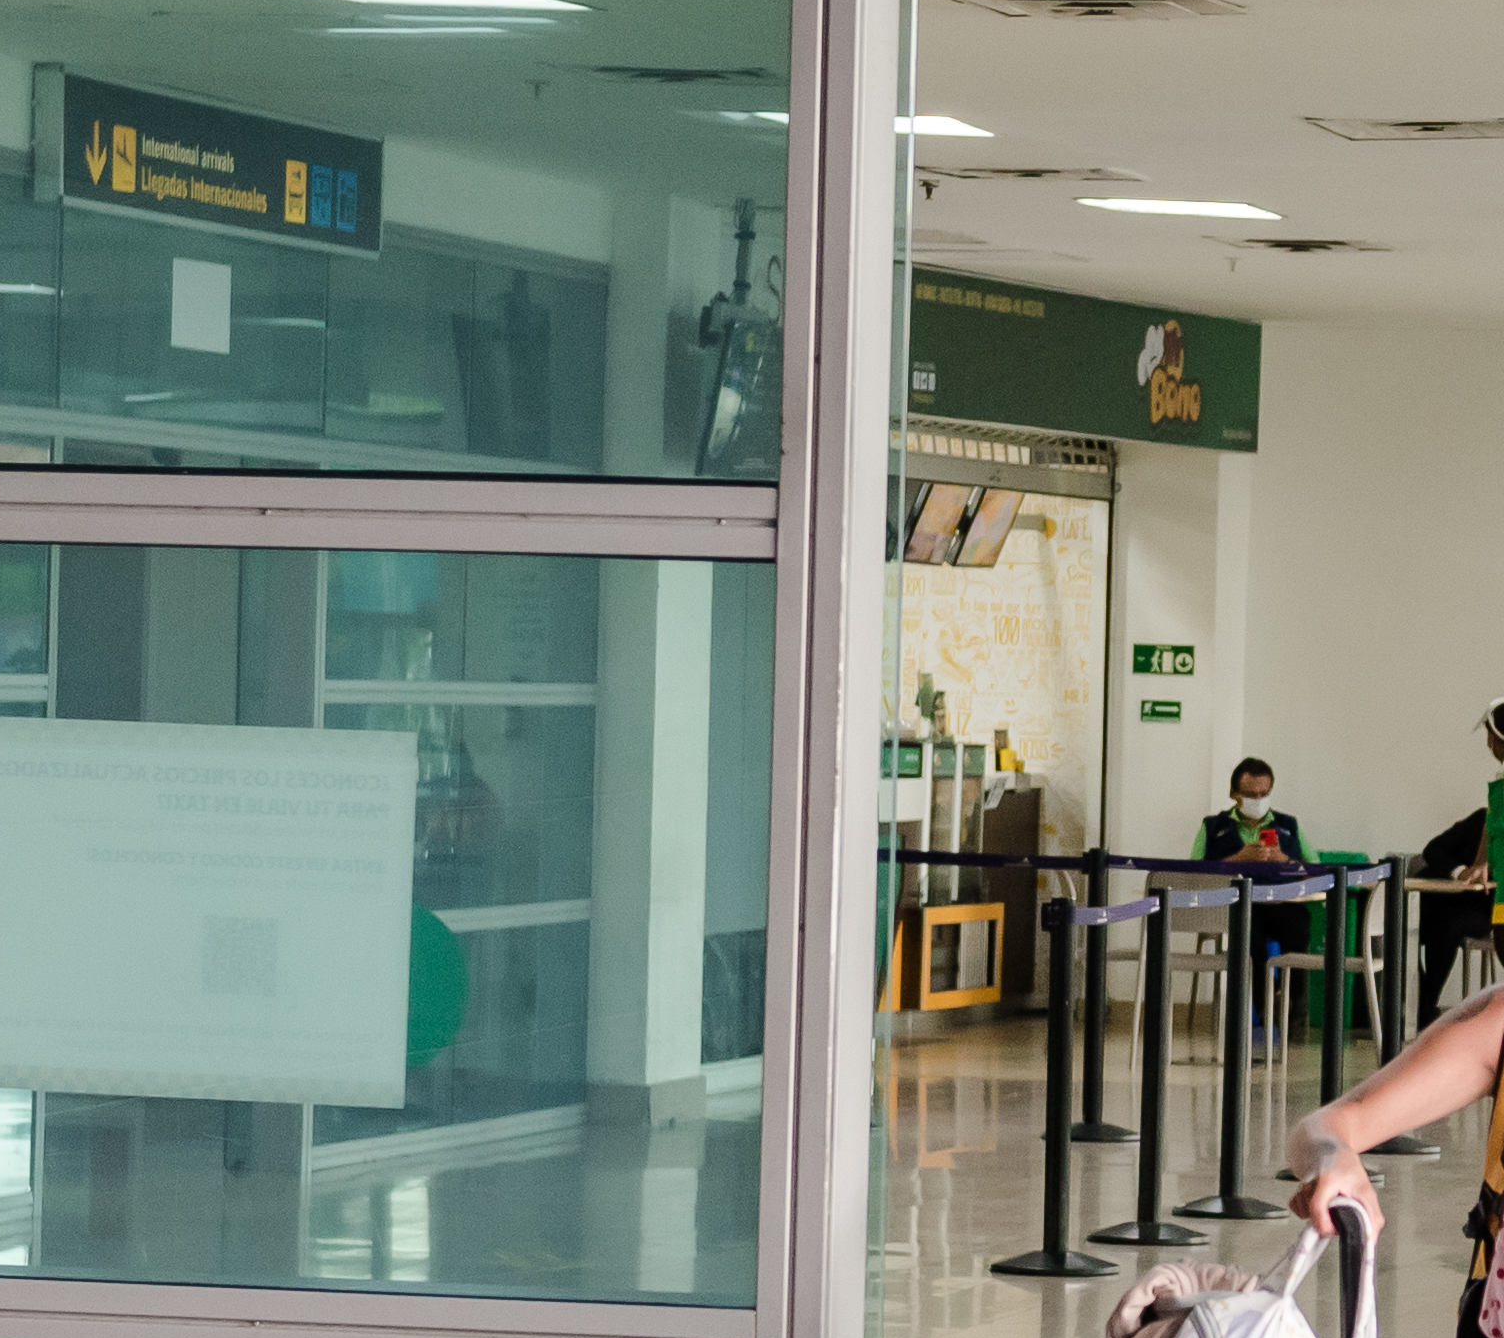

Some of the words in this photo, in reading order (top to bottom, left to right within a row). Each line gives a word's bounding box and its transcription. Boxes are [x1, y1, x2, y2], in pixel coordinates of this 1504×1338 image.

[142, 133, 200, 166] International
[201, 147, 235, 173] arrivals
[142, 166, 188, 201] Llegadas
[190, 175, 268, 213] Internacionales
